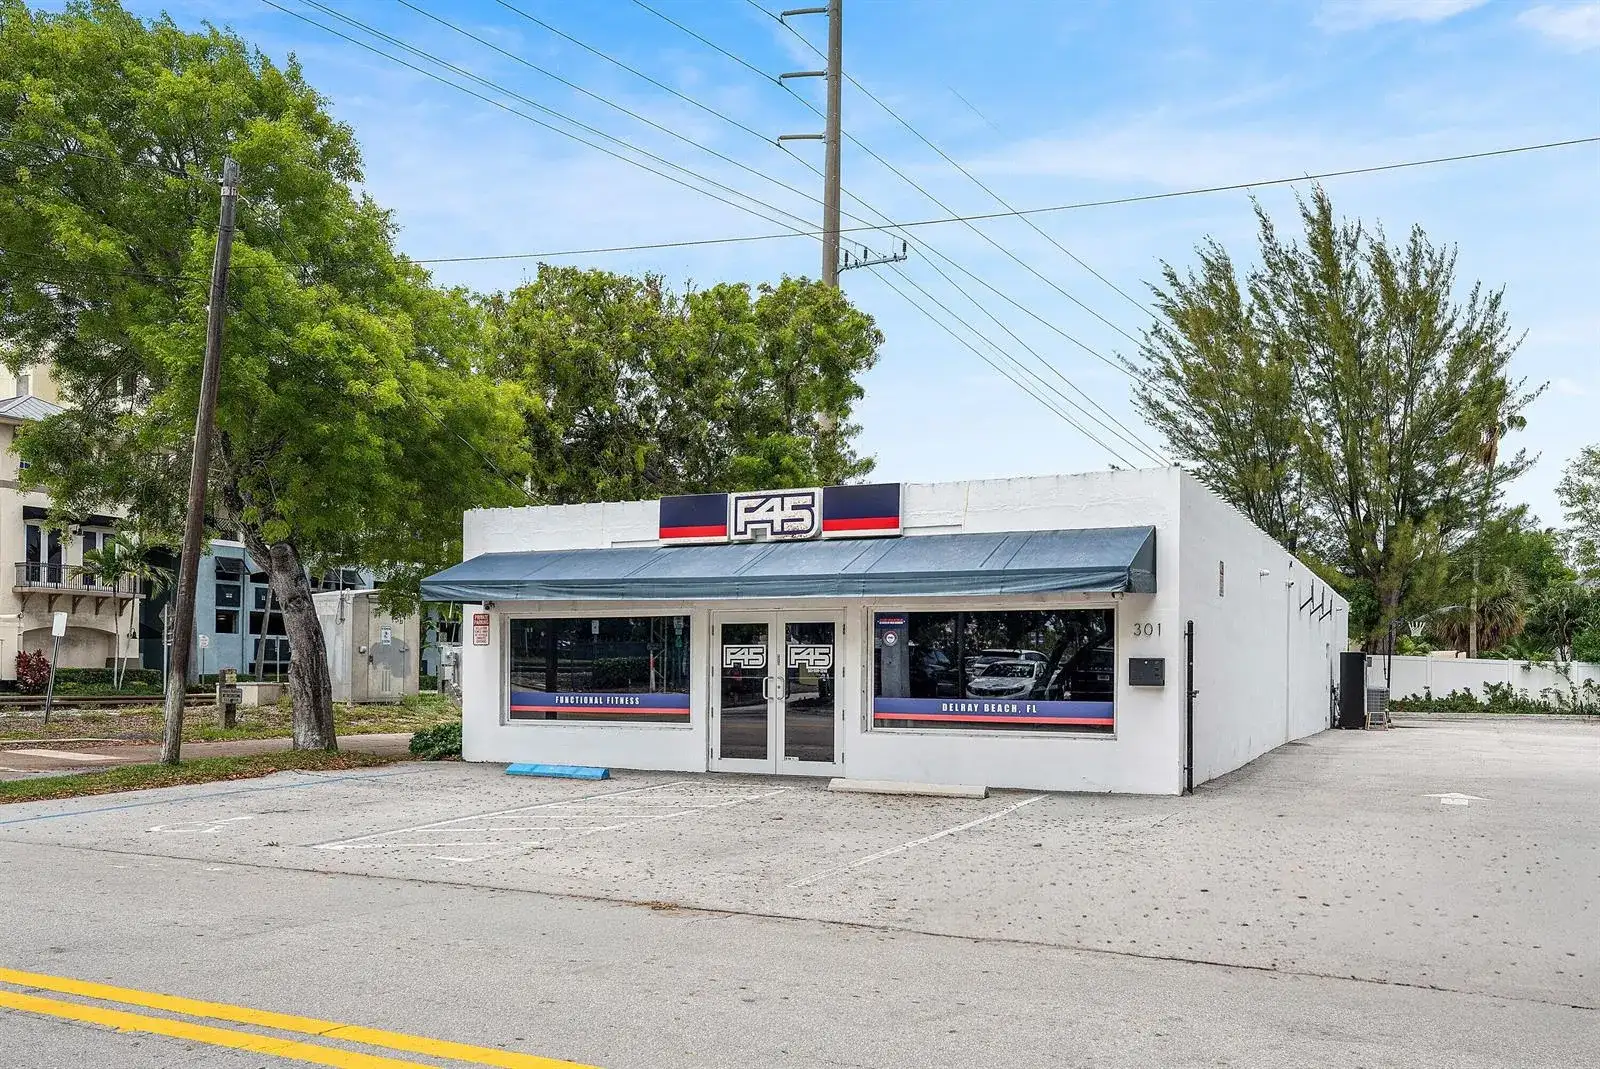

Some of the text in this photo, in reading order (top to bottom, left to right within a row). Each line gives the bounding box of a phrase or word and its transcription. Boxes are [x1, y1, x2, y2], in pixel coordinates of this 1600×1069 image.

[734, 491, 816, 536] F45
[1134, 622, 1161, 637] 301
[723, 644, 767, 669] F45
[787, 644, 833, 669] F45
[555, 696, 640, 705] FUNCTIONAL FITNESS
[942, 703, 1037, 714] DELRAY BEACH, FL
